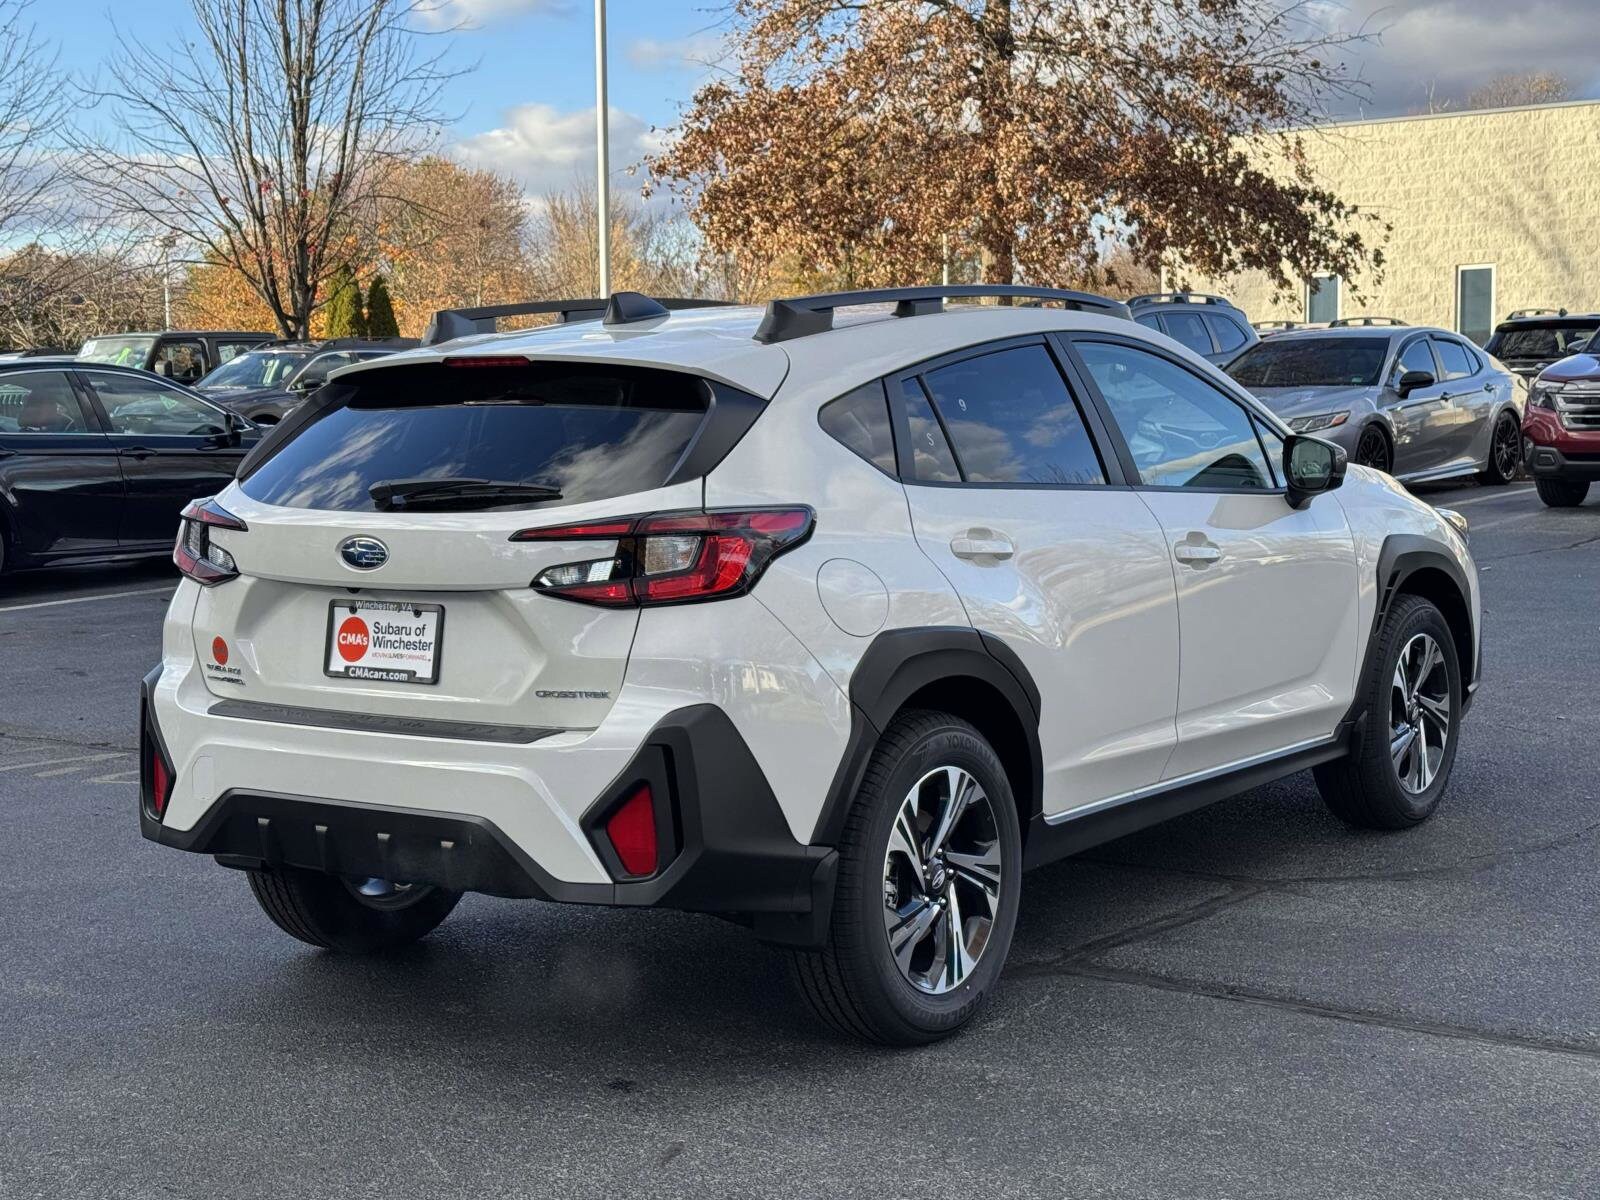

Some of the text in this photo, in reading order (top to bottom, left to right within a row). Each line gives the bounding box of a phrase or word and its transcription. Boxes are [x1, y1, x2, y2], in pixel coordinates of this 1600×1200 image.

[355, 600, 413, 613] Winchester, VA
[373, 621, 427, 637] Subaru of
[339, 633, 368, 646] CMA's
[372, 635, 433, 652] Winchester
[348, 667, 408, 681] CMAcars.com
[535, 690, 611, 699] CROSSTREK
